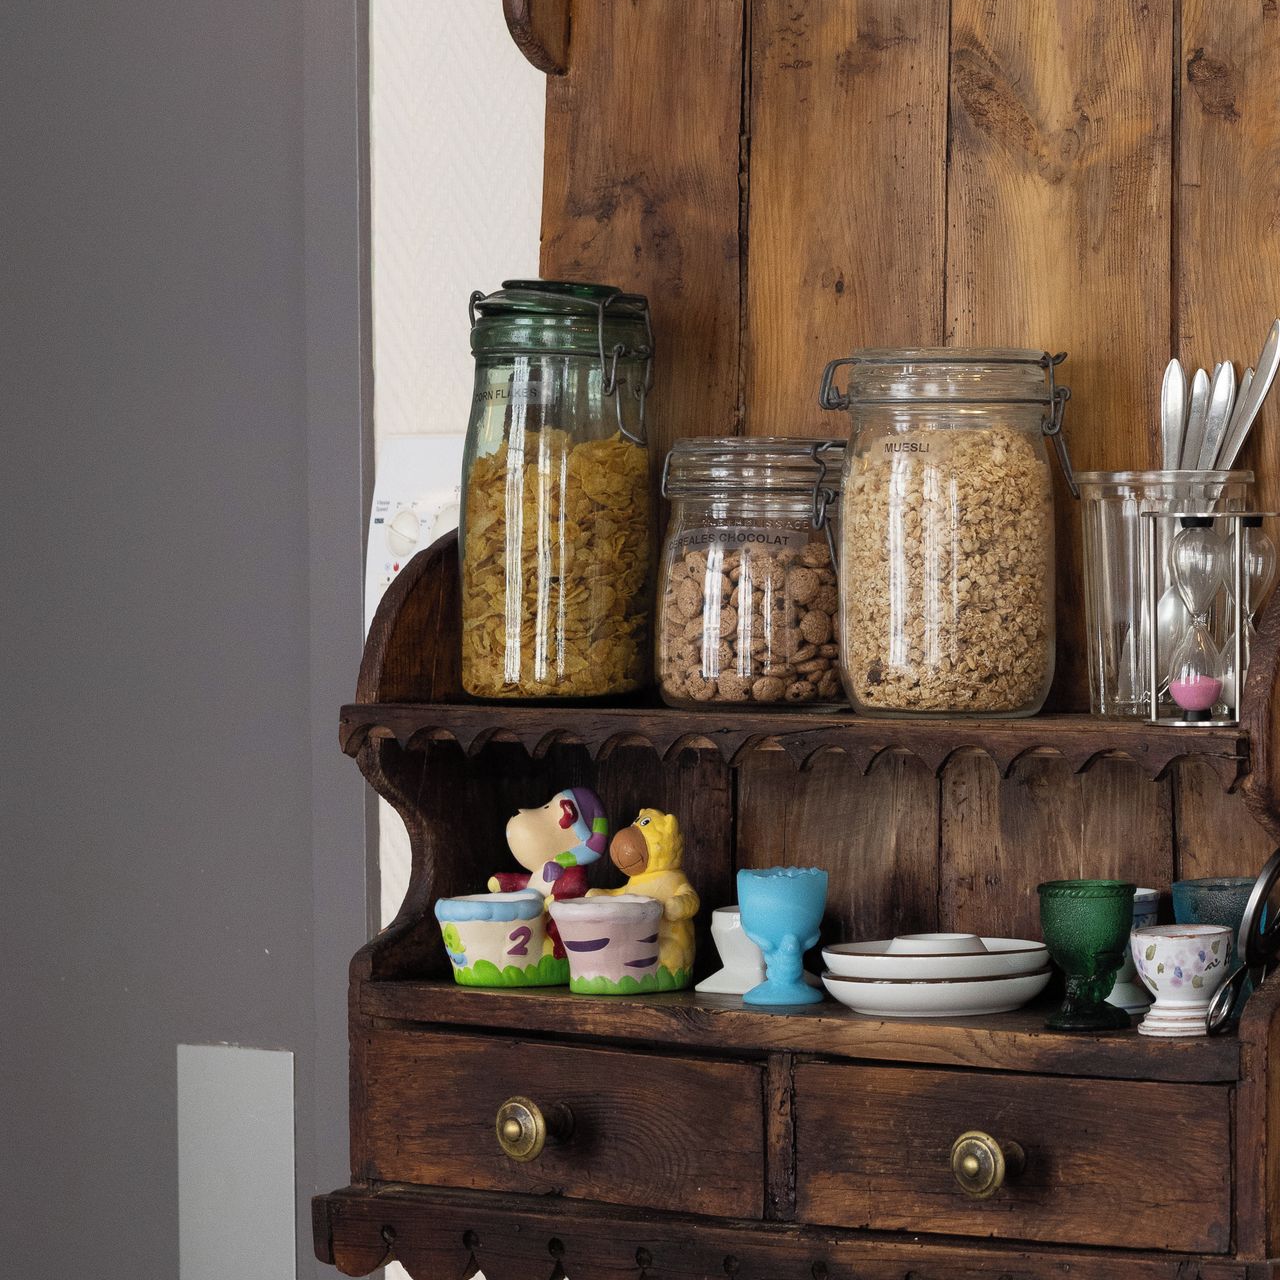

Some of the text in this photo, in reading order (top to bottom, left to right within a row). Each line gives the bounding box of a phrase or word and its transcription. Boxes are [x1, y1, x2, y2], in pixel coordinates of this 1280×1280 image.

[495, 387, 537, 399] FLAKES
[884, 442, 930, 453] MUESLI
[719, 533, 790, 546] CHOCOLAT
[506, 926, 532, 956] 2
